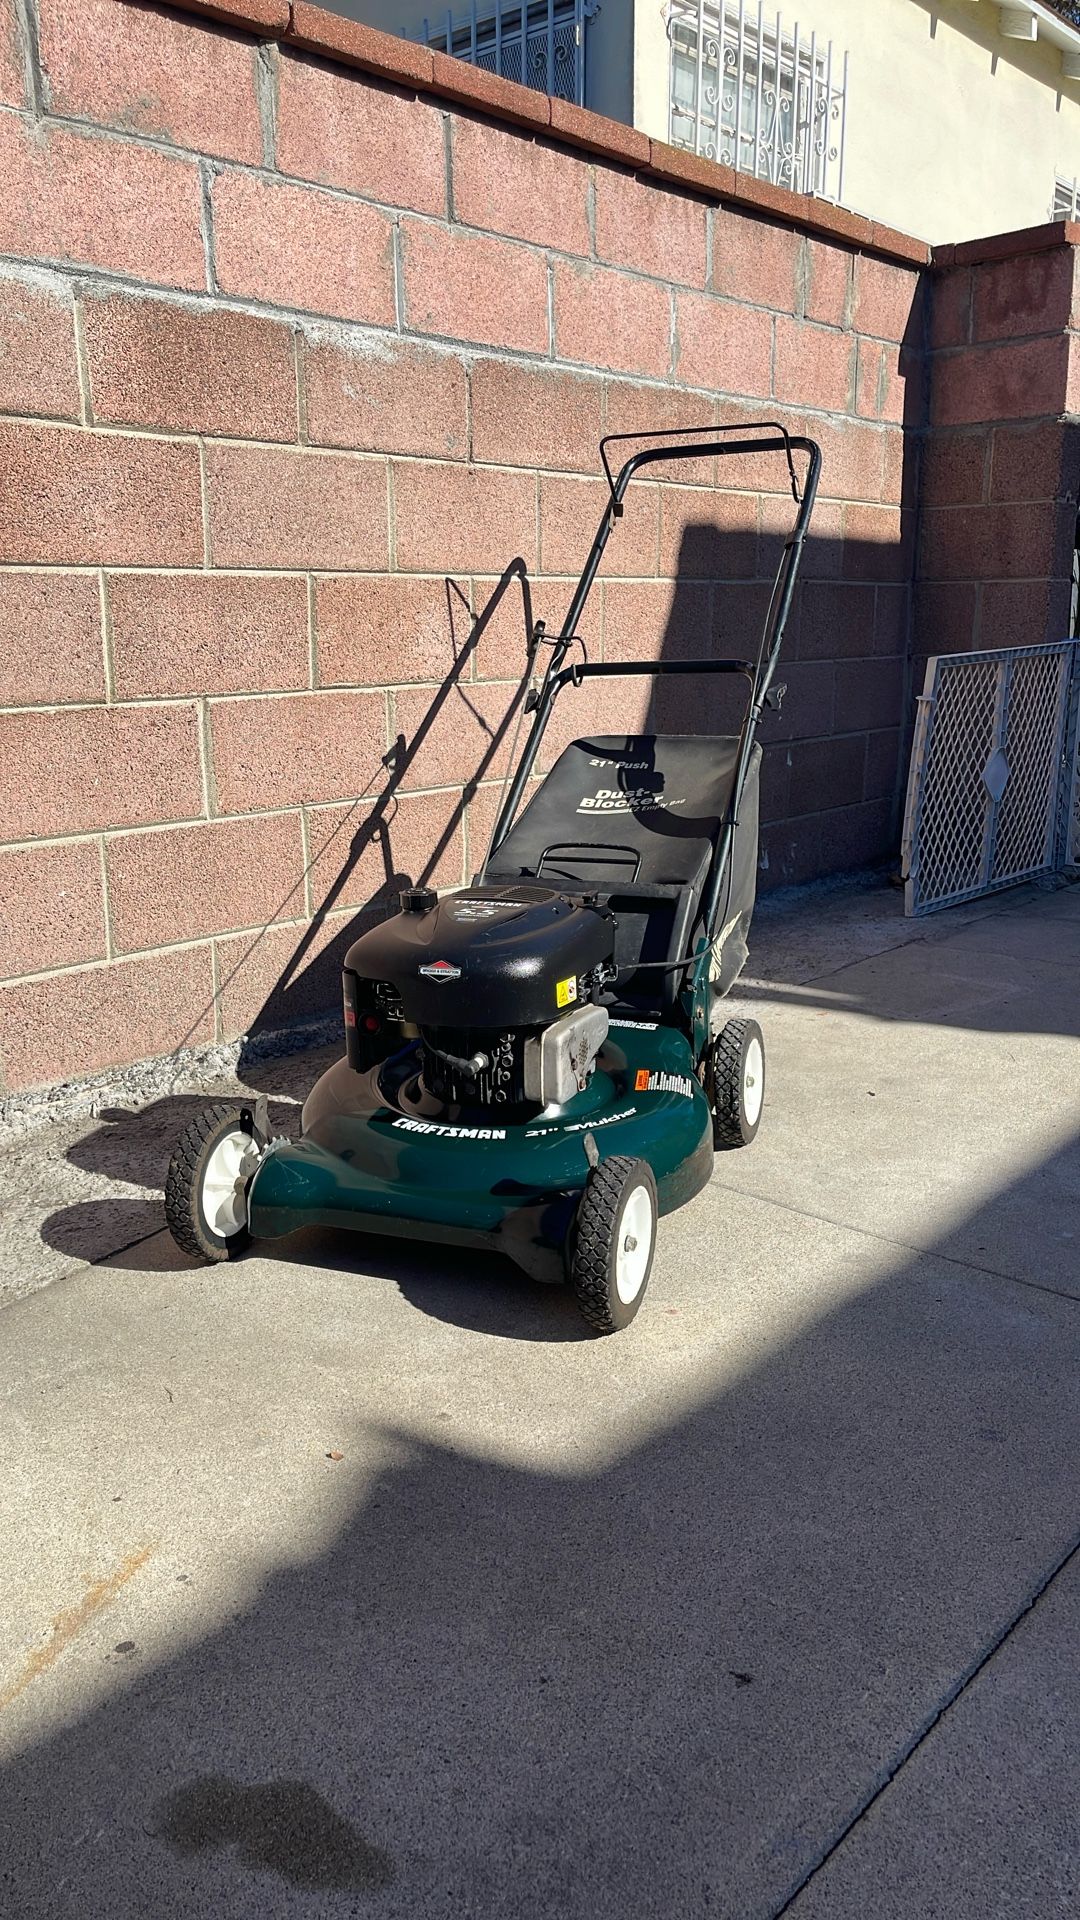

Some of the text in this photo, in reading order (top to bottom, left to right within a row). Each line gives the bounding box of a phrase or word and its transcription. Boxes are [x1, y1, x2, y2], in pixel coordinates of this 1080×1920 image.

[589, 759, 649, 770] 21" Push
[594, 788, 651, 799] Dust-
[579, 795, 664, 808] Blocker
[391, 1107, 637, 1140] CRAFTSMAN 21" Mulcher
